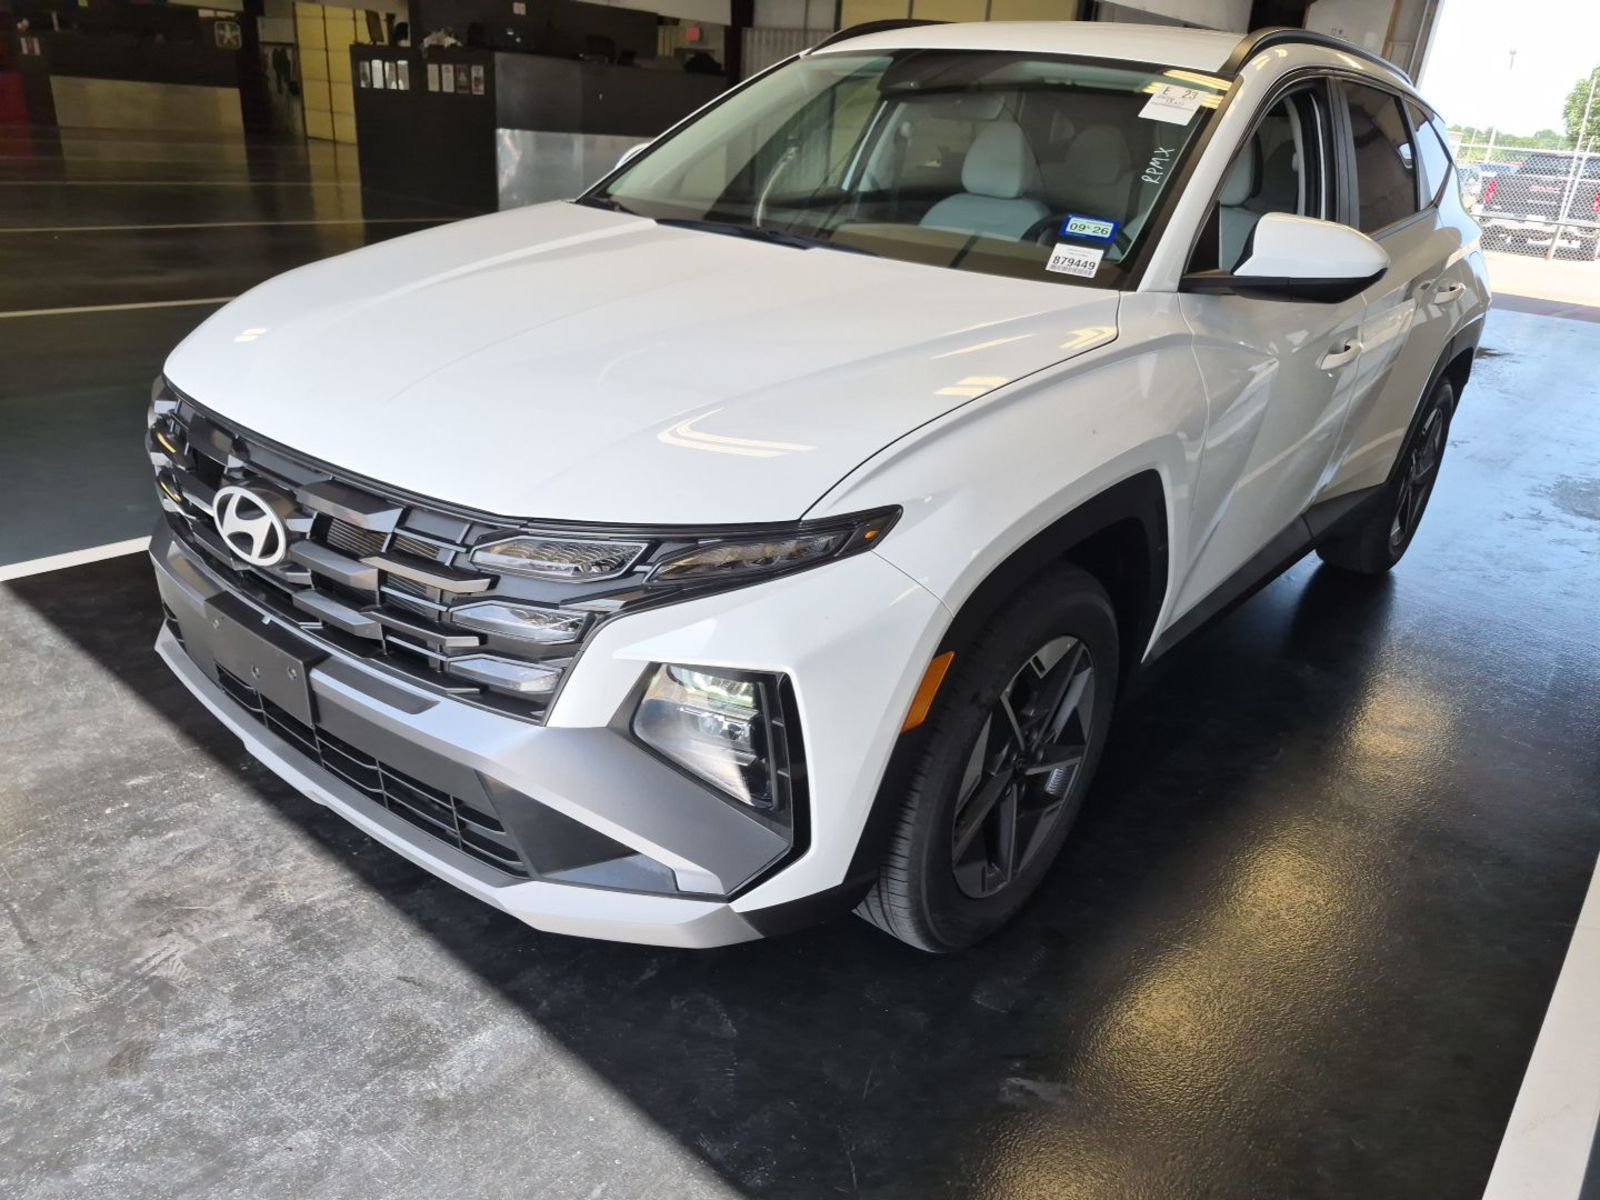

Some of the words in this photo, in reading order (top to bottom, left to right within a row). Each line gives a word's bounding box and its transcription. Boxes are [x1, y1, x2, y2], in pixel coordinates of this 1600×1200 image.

[1141, 147, 1175, 183] RPMX
[1069, 223, 1087, 232] 09
[1092, 226, 1110, 235] 26
[1053, 256, 1096, 271] 879449
